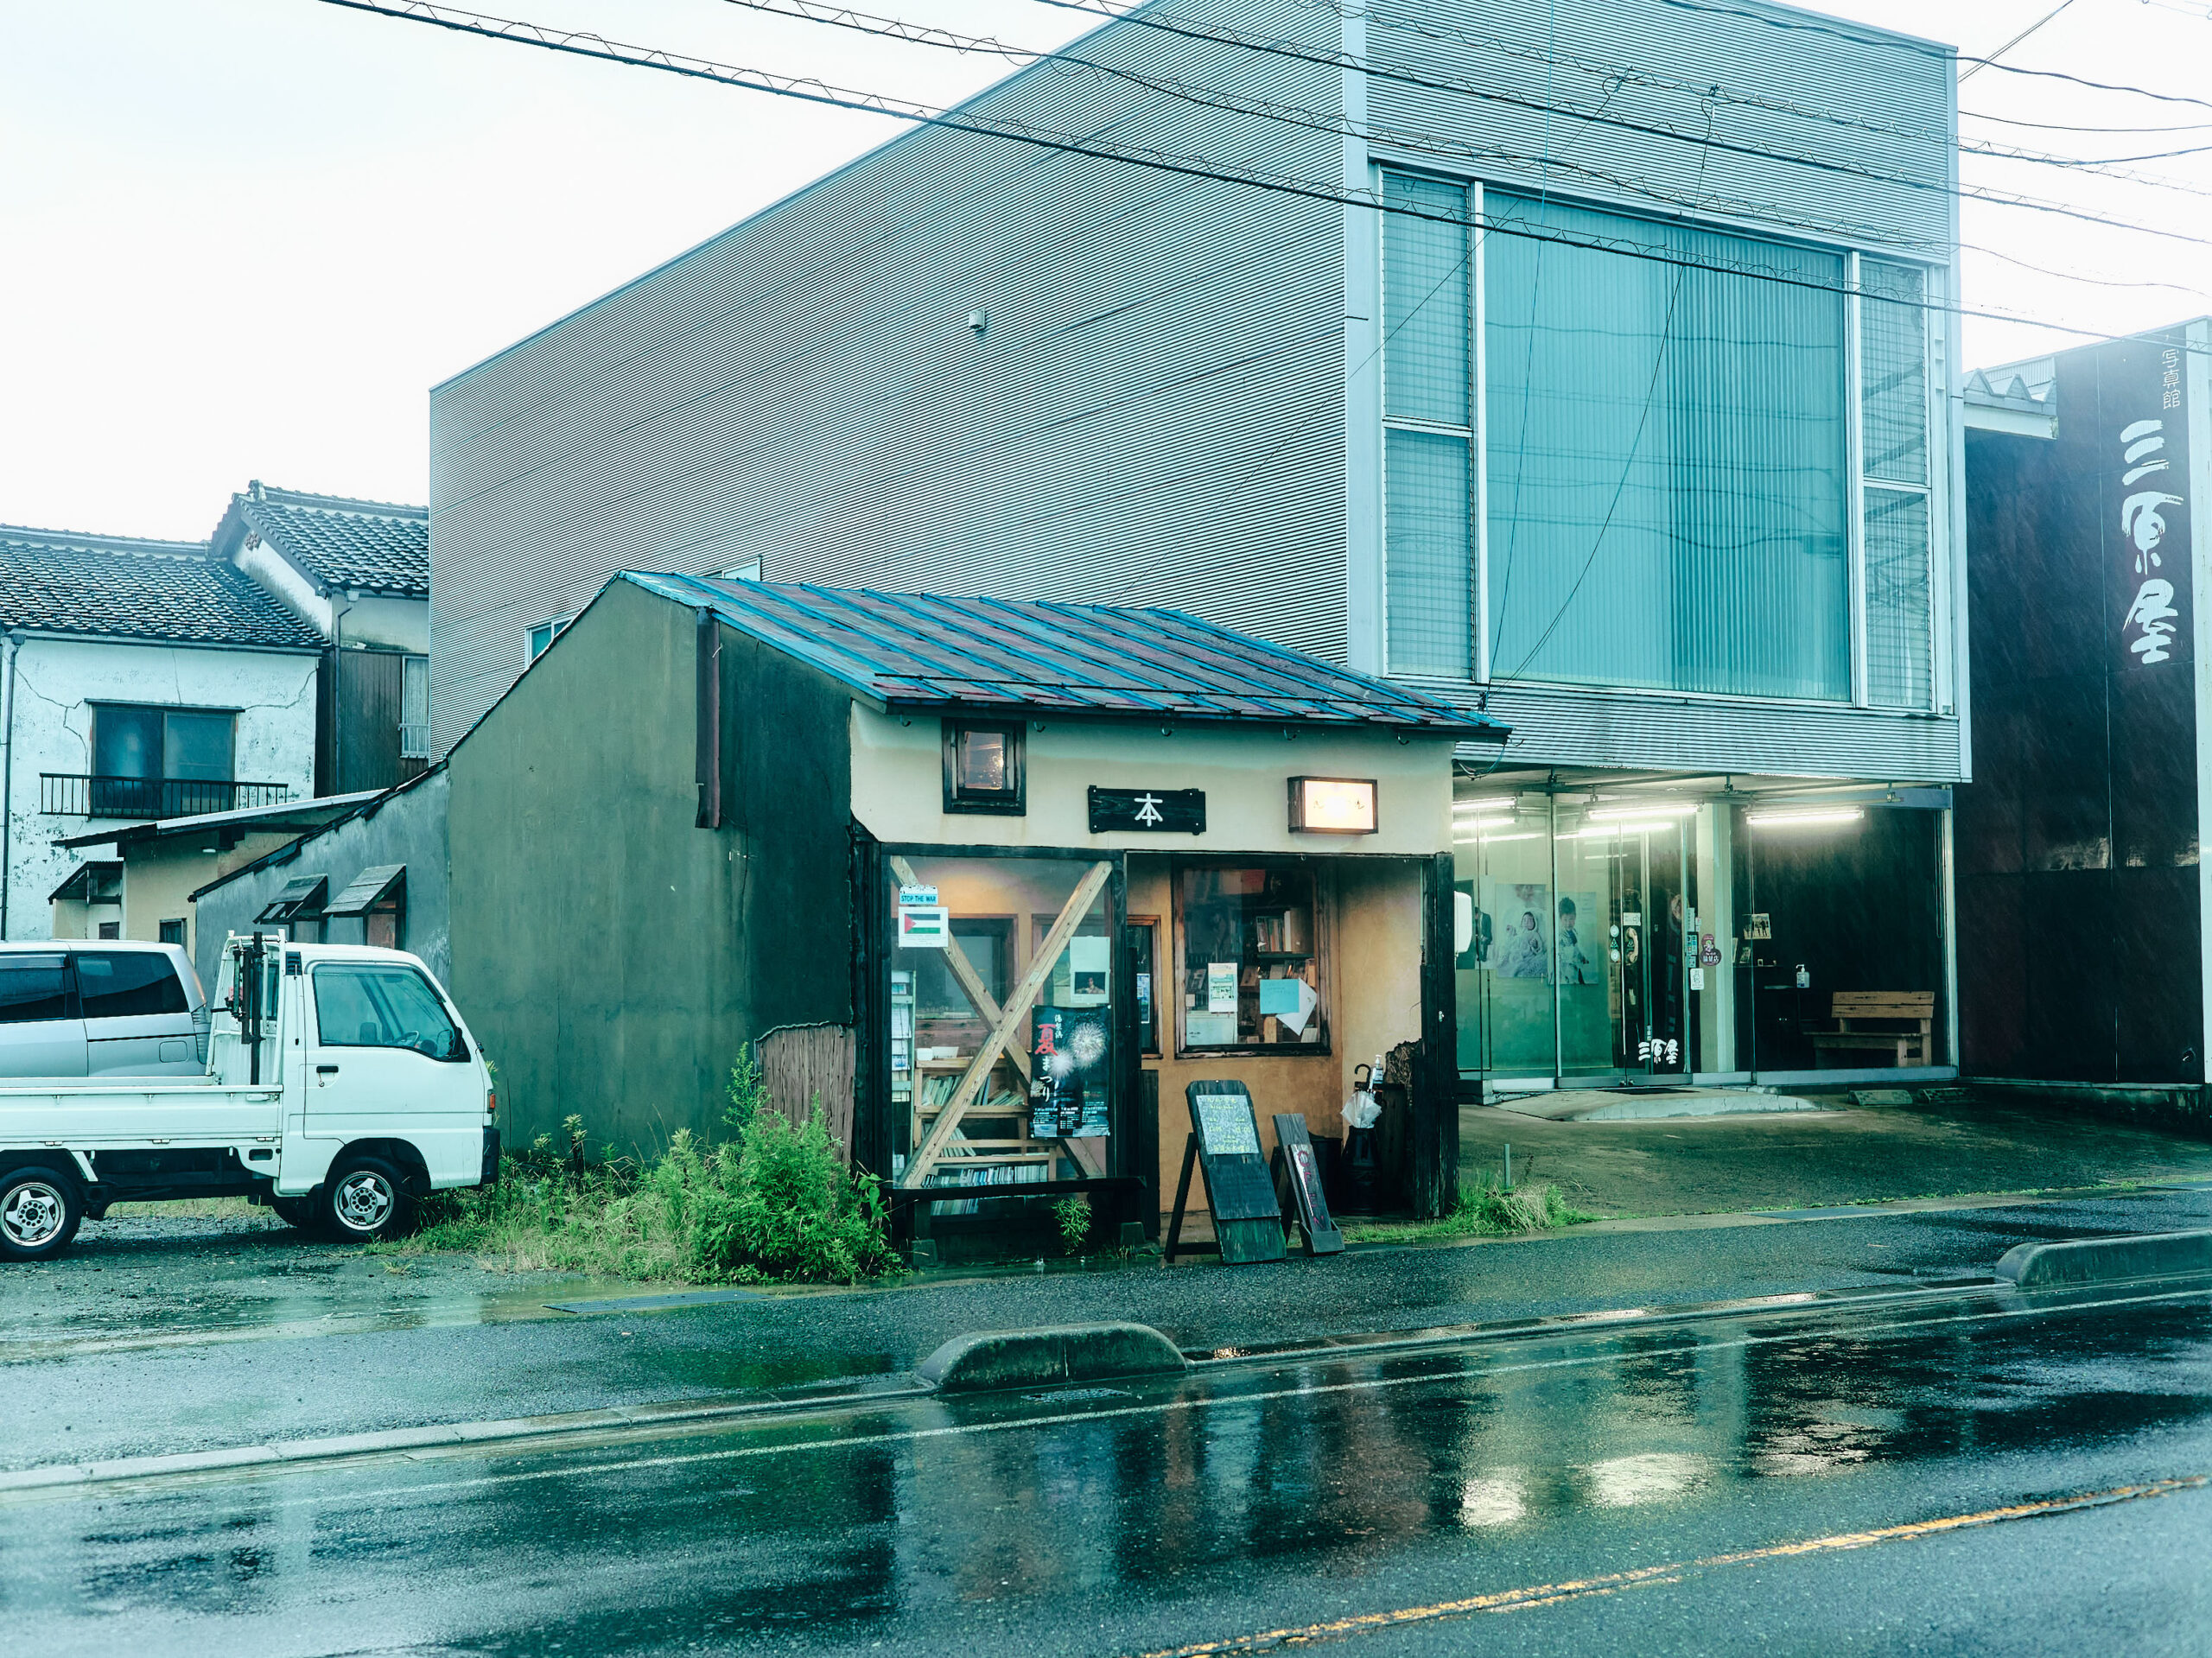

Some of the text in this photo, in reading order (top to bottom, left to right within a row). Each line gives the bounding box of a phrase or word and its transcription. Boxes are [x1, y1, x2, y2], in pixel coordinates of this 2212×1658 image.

[2162, 349, 2181, 410] 写真館
[2120, 419, 2184, 664] 三原屋
[1135, 792, 1164, 827] 本
[1034, 1023, 1058, 1102] 夏まつり
[1637, 1039, 1679, 1065] 三原屋
